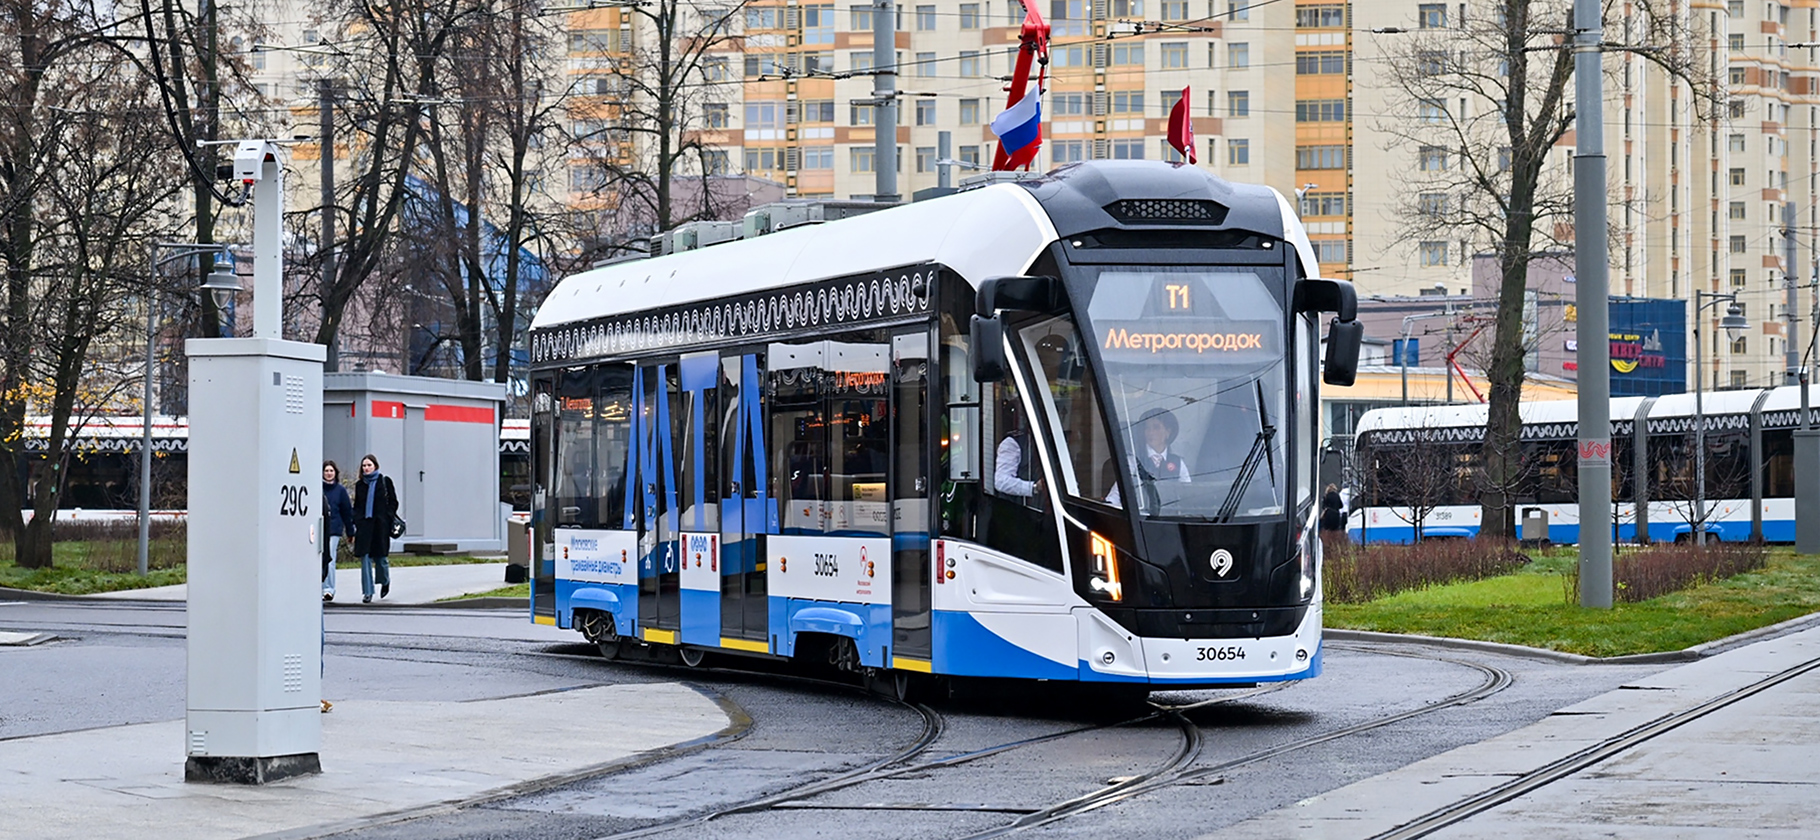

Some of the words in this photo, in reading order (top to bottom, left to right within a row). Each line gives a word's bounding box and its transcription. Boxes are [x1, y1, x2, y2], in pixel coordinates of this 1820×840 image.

[1165, 284, 1190, 309] Т1
[1104, 328, 1262, 354] Метрогородок
[814, 553, 838, 577] 30654
[1196, 646, 1246, 661] 30654
